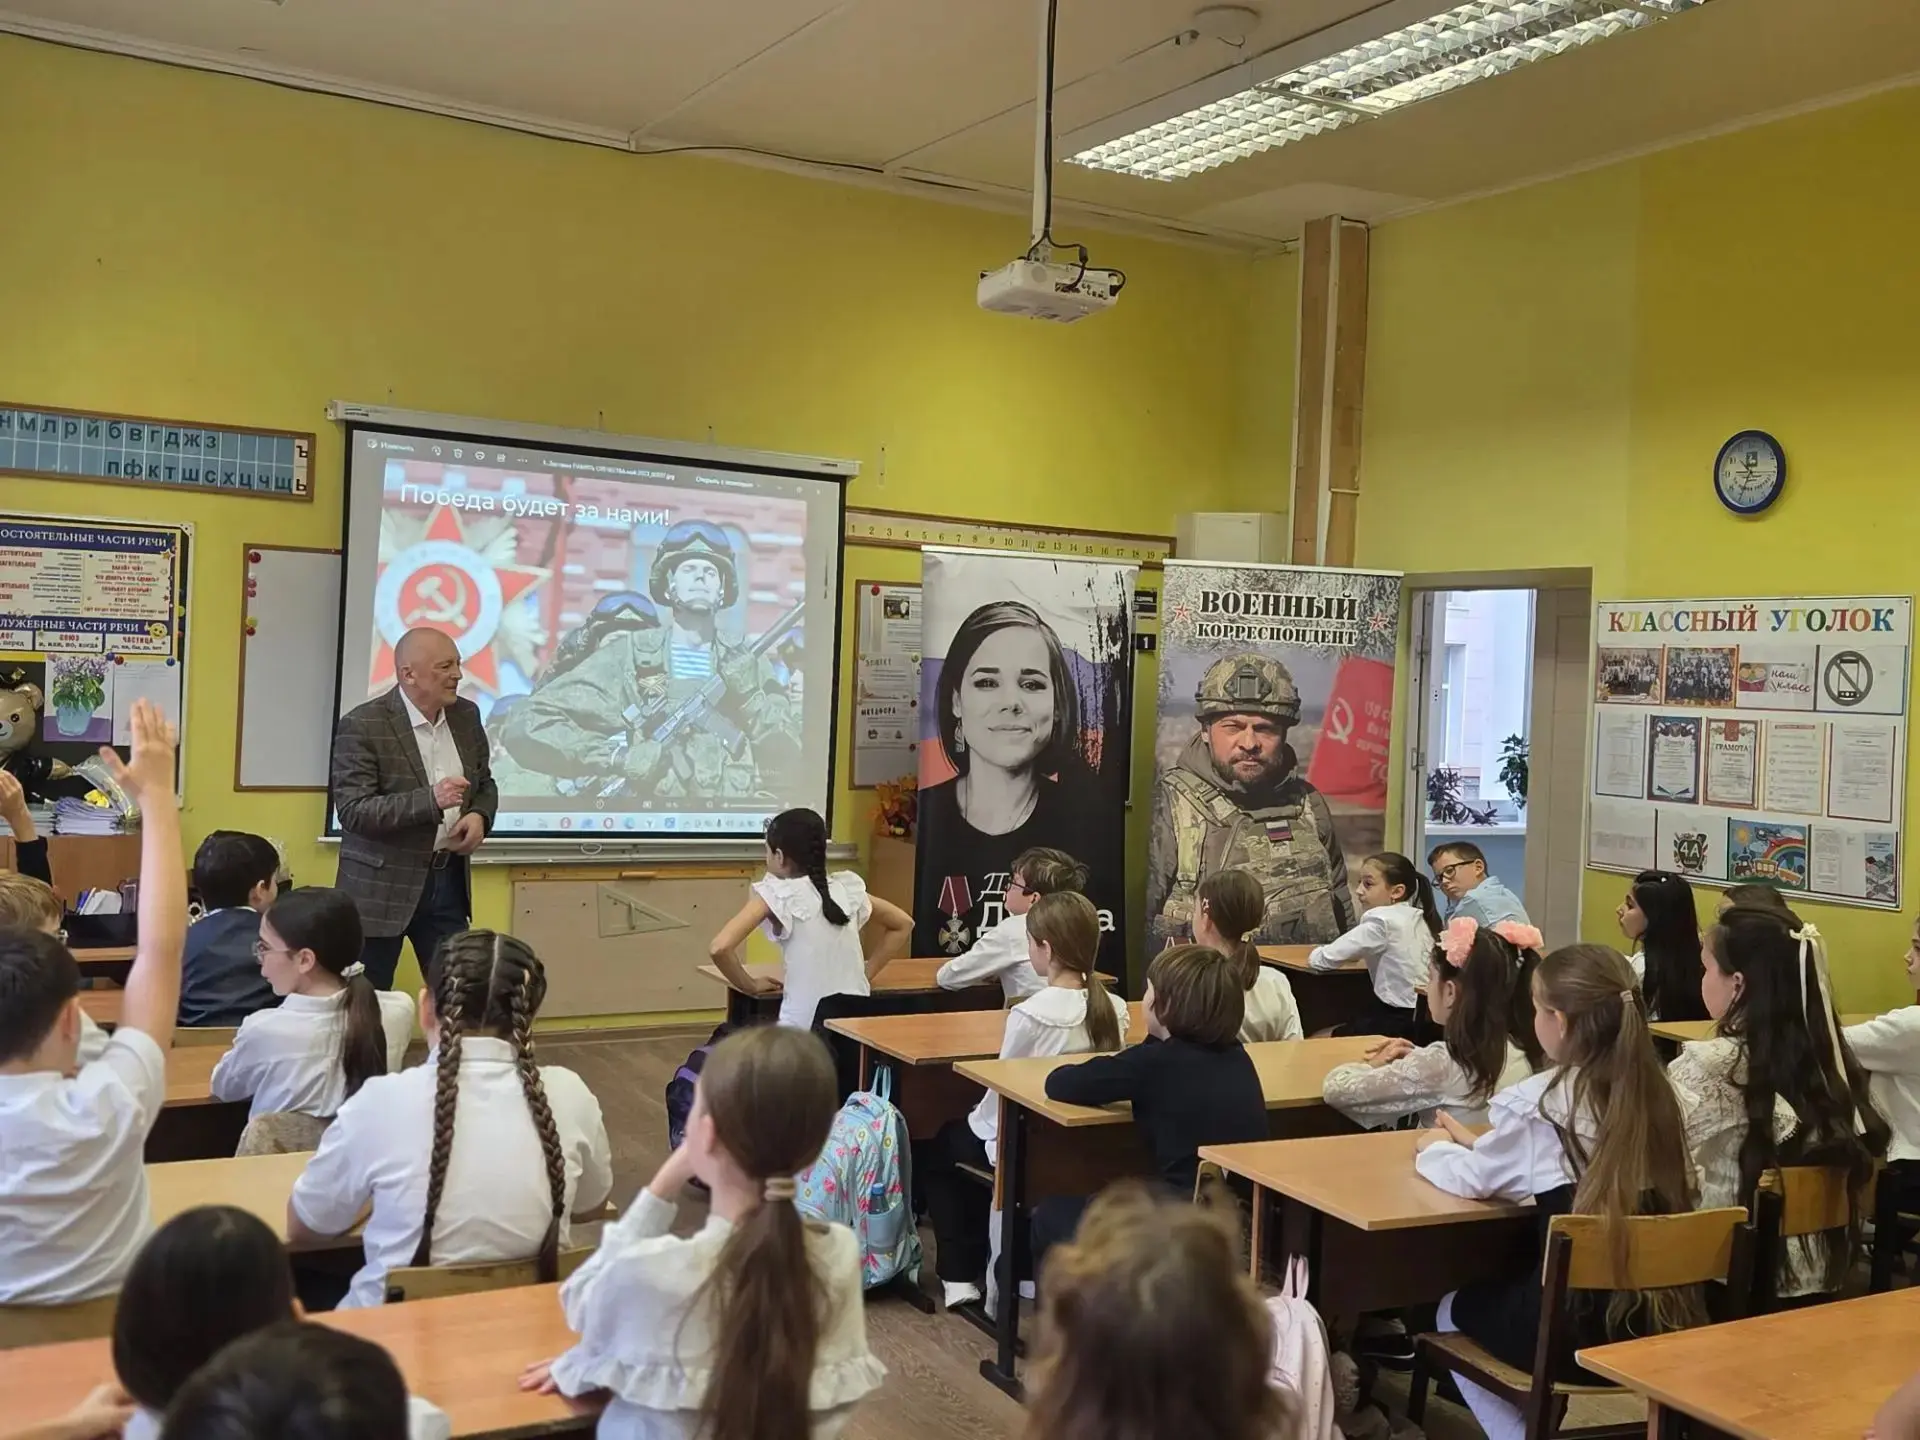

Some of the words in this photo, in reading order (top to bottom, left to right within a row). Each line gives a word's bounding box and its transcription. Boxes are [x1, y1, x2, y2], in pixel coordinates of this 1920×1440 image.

[401, 484, 494, 511] Победа
[503, 494, 569, 516] будет
[575, 505, 599, 519] за
[607, 507, 670, 526] нами!
[97, 534, 136, 545] ЧАСТИ
[138, 537, 167, 547] РЕЧИ
[1005, 538, 1013, 546] 10
[1037, 541, 1045, 549] 12
[1054, 542, 1061, 550] 13
[1070, 543, 1077, 551] 14
[1085, 545, 1093, 553] 15
[1101, 547, 1109, 555] 16
[1116, 548, 1124, 556] 17
[1200, 590, 1358, 621] ВОЕННЫЙ
[68, 620, 107, 632] ЧАСТИ
[109, 622, 139, 633] РЕЧИ
[1608, 604, 1757, 632] КЛАССНЫЙ
[1770, 608, 1895, 632] УГОЛОК
[1143, 636, 1149, 649] 1
[1197, 623, 1358, 645] КОРРЕСПОНДЕНТ
[1715, 743, 1749, 752] ГРАМОТА
